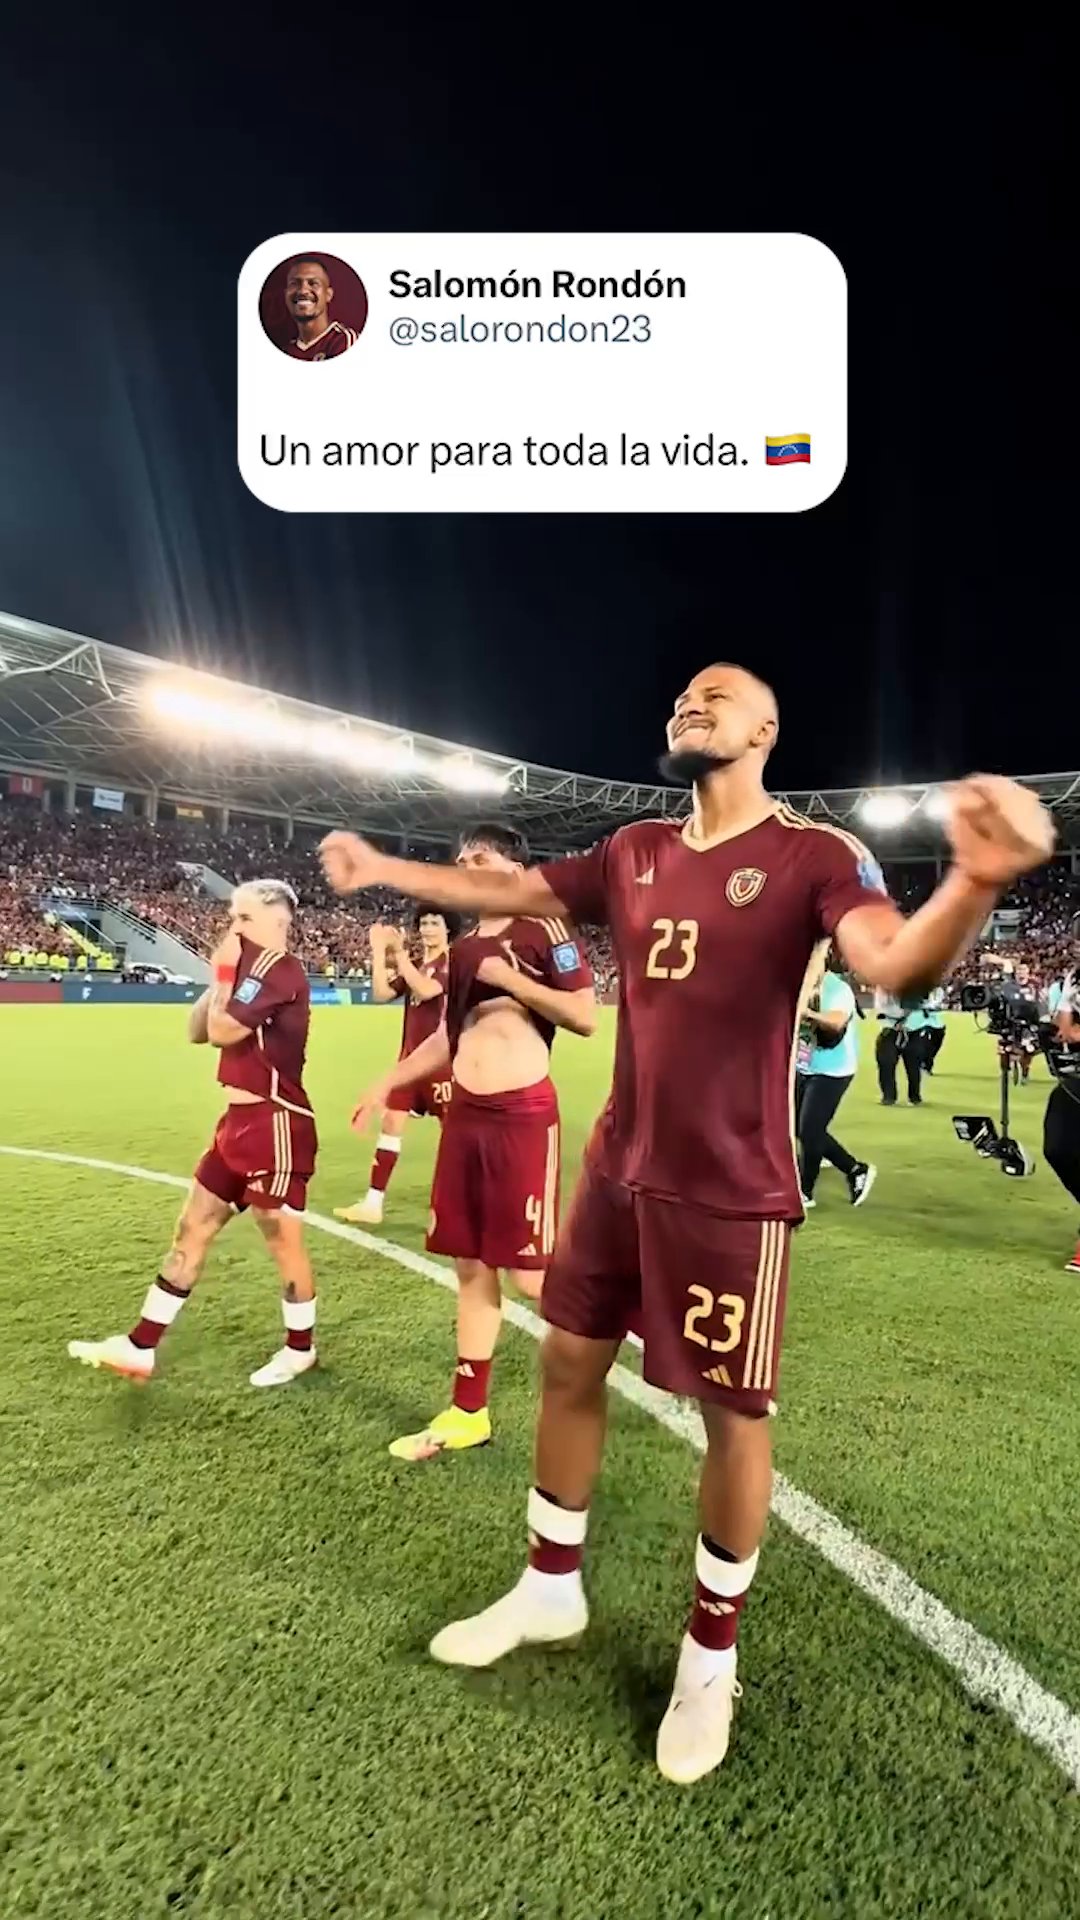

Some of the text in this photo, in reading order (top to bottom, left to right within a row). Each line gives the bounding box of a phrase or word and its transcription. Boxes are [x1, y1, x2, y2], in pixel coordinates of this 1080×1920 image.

[646, 917, 699, 980] 23
[431, 1080, 452, 1104] 20
[525, 1194, 542, 1236] 4
[683, 1283, 745, 1353] 23
